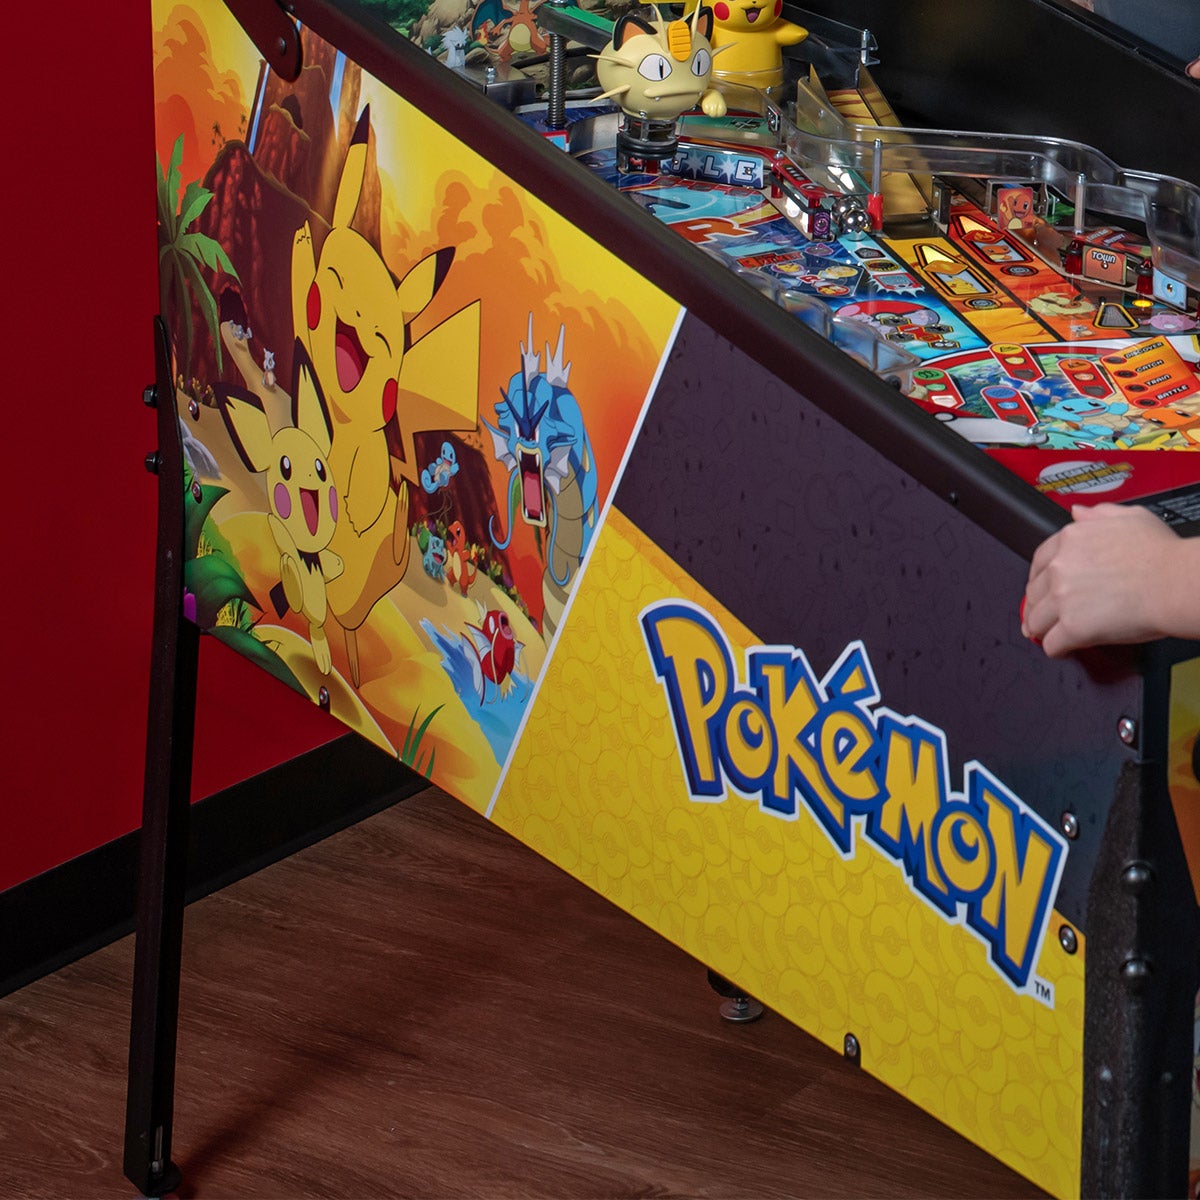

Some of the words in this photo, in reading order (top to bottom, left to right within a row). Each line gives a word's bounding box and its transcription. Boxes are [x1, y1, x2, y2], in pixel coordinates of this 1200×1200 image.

[1125, 341, 1163, 358] DISCOVER
[1136, 360, 1163, 372] CATCH
[1146, 374, 1171, 386] TRAIN
[1156, 385, 1189, 400] BATTLE
